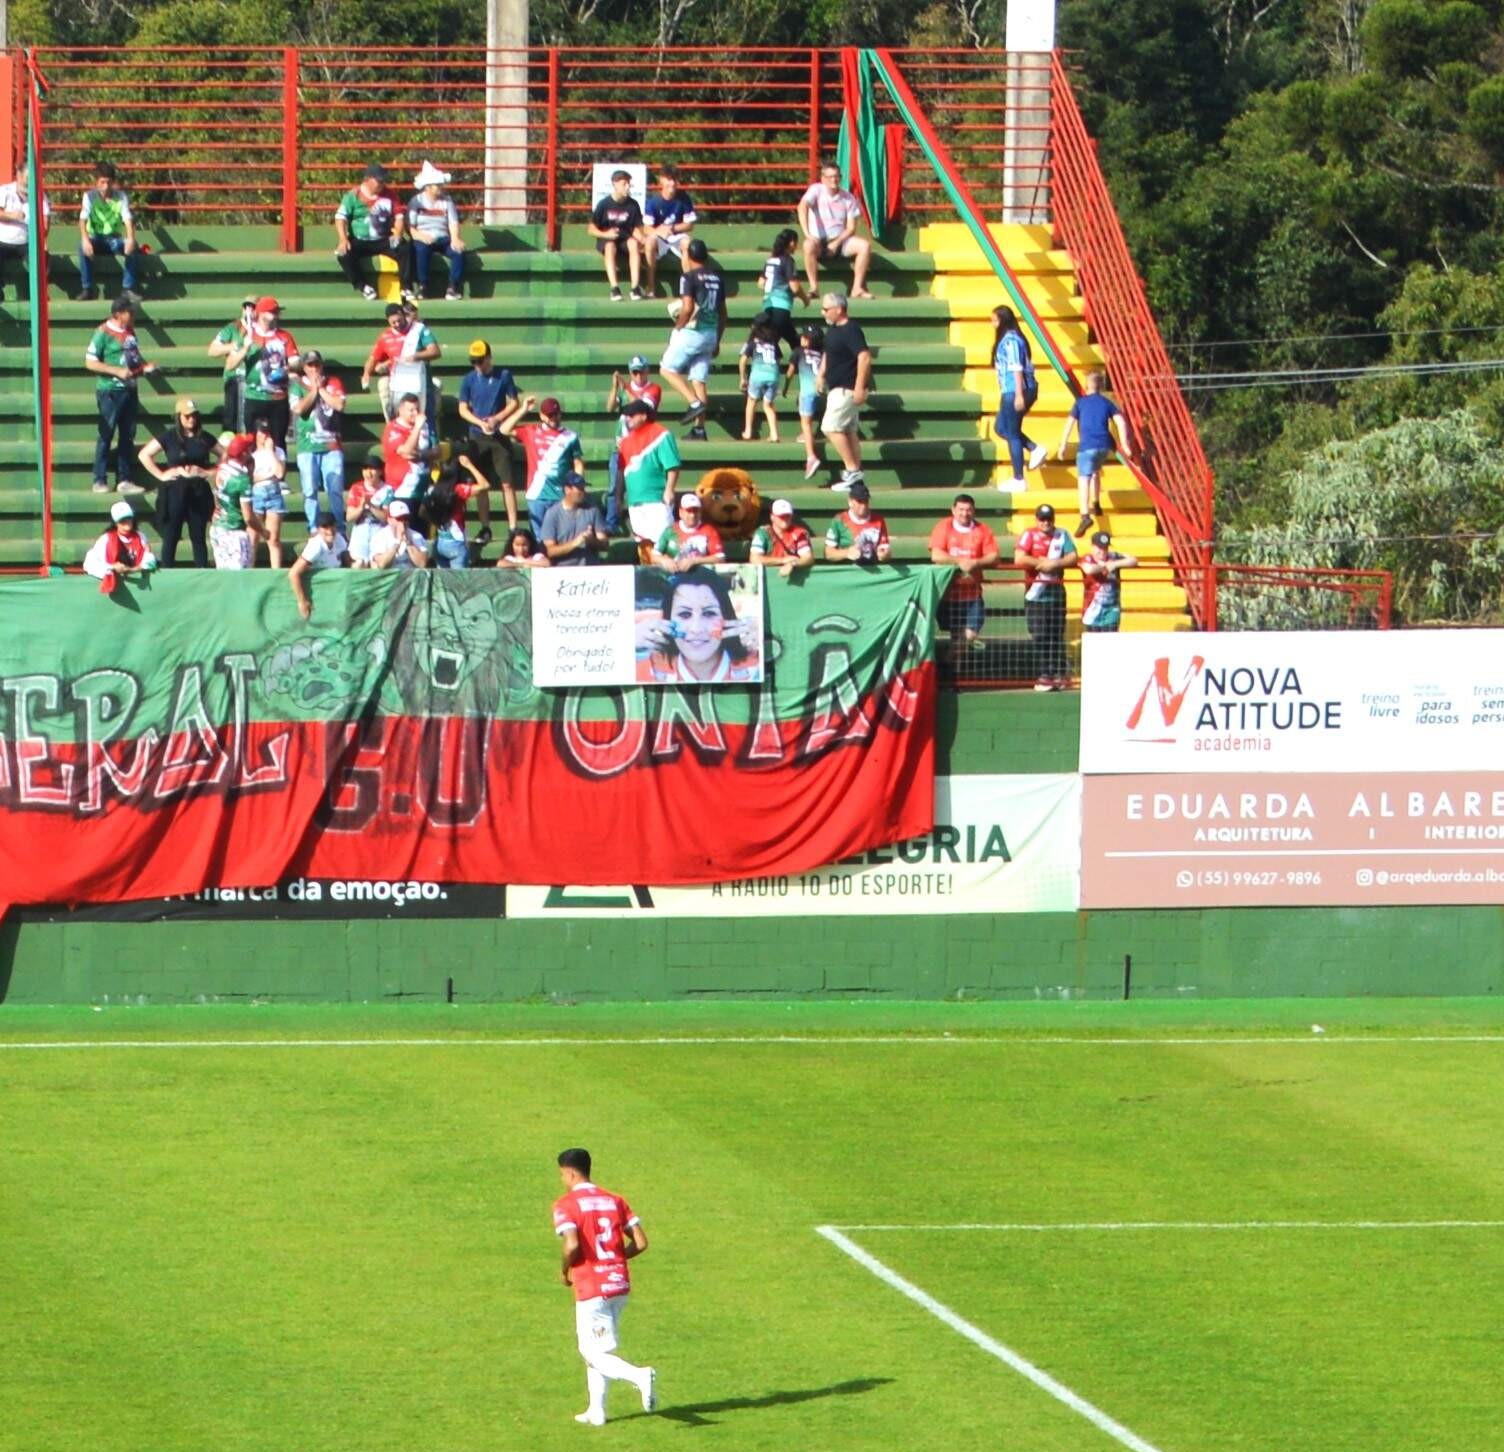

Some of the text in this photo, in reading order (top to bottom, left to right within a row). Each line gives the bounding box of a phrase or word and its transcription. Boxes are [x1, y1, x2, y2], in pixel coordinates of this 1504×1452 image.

[556, 579, 611, 598] Katieli
[555, 645, 614, 660] Obrigado
[553, 663, 578, 679] por
[1204, 668, 1303, 696] NOVA
[1195, 700, 1342, 730] ATITUDE
[1369, 704, 1400, 717] livre
[1421, 701, 1452, 713] para
[1415, 711, 1460, 724] idosos
[1193, 732, 1272, 752] academia
[1125, 793, 1317, 821] EDUARDA
[1193, 827, 1313, 843] ARQUITETURA
[799, 875, 821, 896] 10
[828, 874, 853, 895] DO
[861, 873, 953, 895] ESPORTE!
[1196, 869, 1322, 888] (55) 99627-9896
[287, 877, 322, 901] da
[595, 1217, 616, 1261] 2
